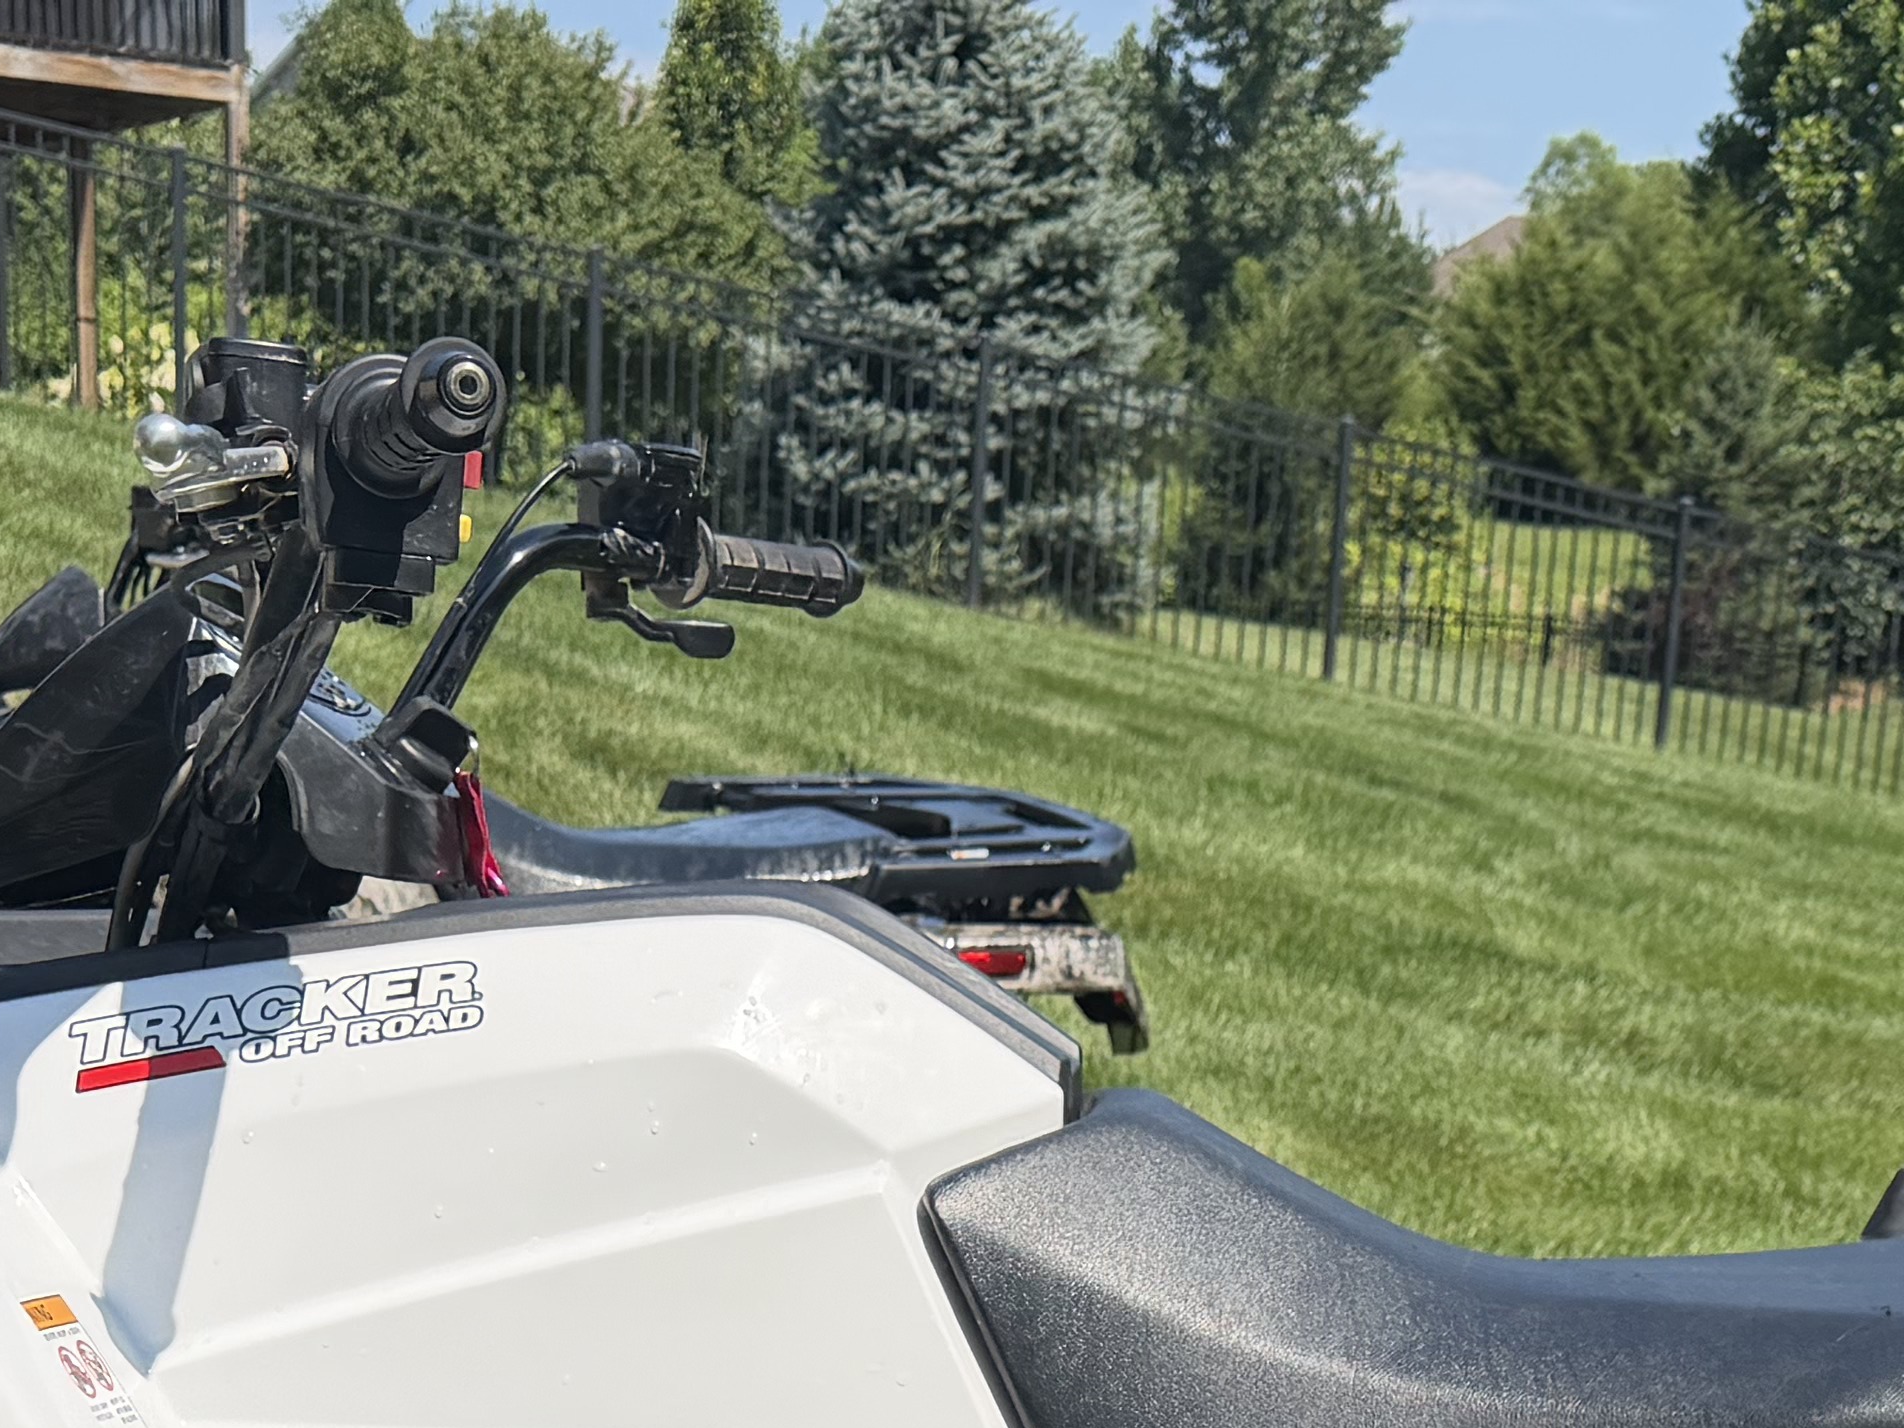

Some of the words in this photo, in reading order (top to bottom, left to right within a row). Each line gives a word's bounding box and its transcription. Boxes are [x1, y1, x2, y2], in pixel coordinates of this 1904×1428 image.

[69, 961, 480, 1065] TRACKER
[239, 1023, 334, 1063] OFF
[346, 1005, 484, 1046] ROAD
